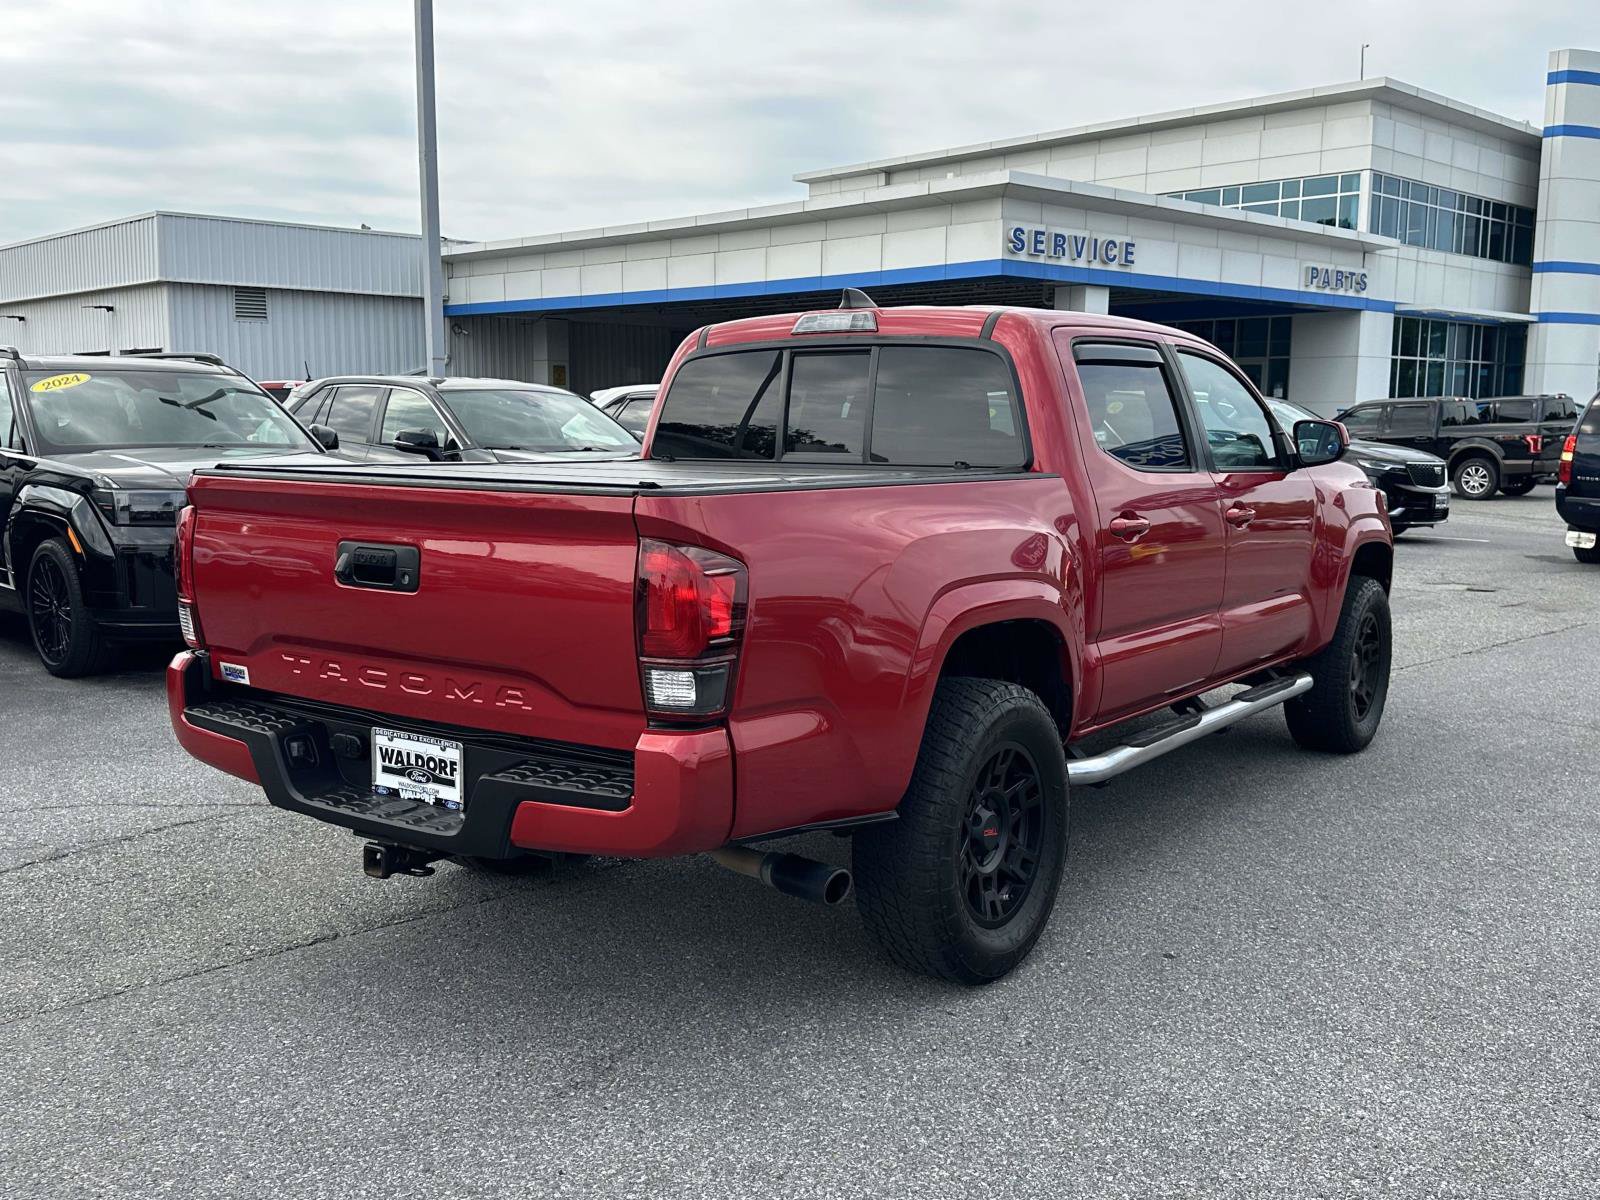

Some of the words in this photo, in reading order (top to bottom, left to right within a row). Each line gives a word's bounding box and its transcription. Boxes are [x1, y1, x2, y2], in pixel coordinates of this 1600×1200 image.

[1008, 227, 1136, 266] SERVICE
[1304, 266, 1367, 291] PARTS
[42, 374, 81, 390] 2024
[281, 652, 532, 711] TACOMA
[375, 729, 409, 739] DEDICATED
[410, 734, 418, 742] TO
[418, 736, 457, 749] EXCELLENCE
[379, 746, 457, 777] WALDORF
[410, 770, 427, 783] Ford
